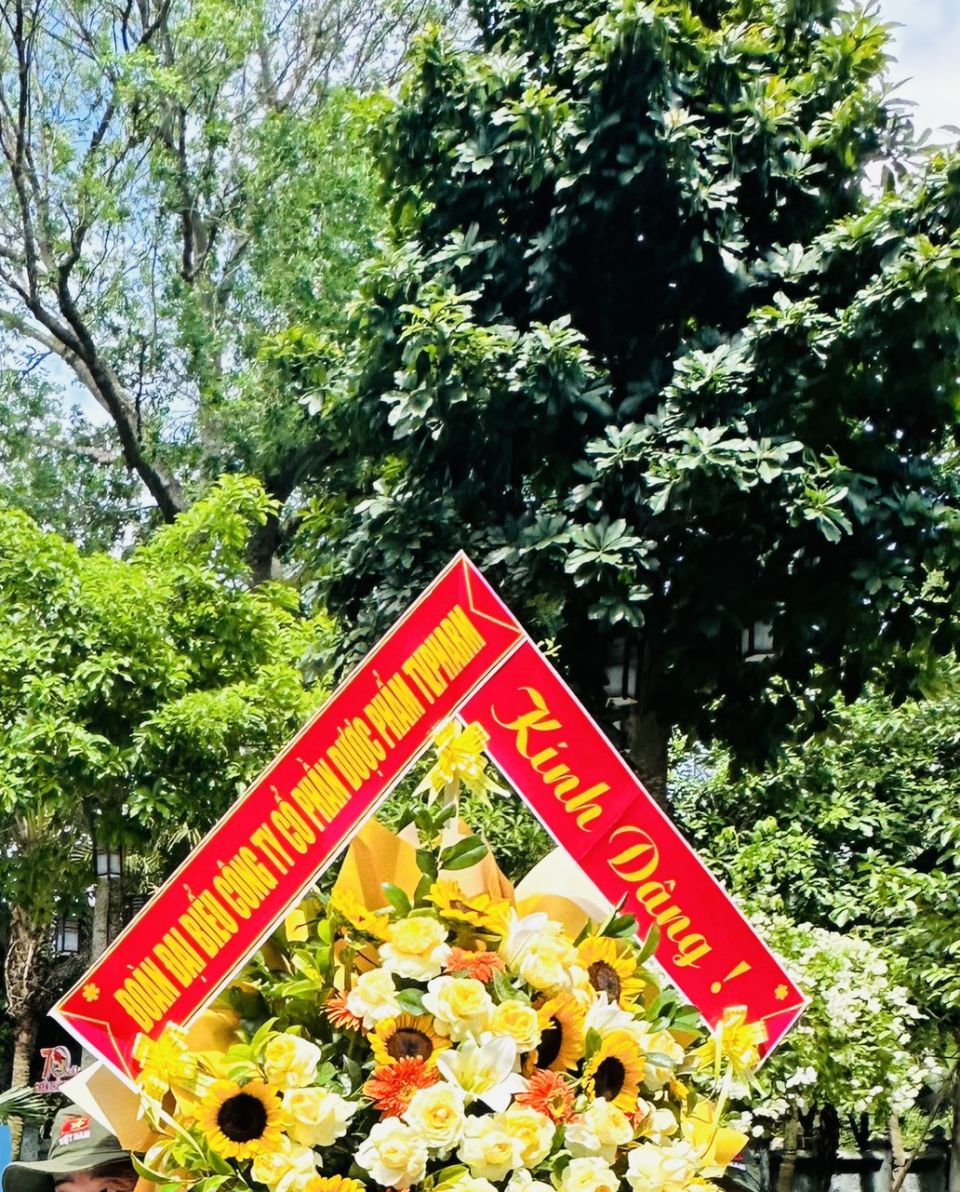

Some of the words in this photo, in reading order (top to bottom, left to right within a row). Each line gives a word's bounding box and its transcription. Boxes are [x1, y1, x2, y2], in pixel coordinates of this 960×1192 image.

[401, 604, 487, 704] TVPHARM
[363, 669, 426, 749] PHẨM
[326, 717, 386, 791] DƯỢC
[270, 785, 316, 854] CỔ
[291, 757, 352, 832] PHẦN
[490, 686, 611, 833] Kính
[608, 825, 713, 969] Dâng
[213, 846, 279, 920] CÔNG
[249, 822, 296, 875] TY
[153, 927, 207, 988] ĐẠI
[178, 884, 239, 959] BIỂU
[113, 957, 181, 1033] ĐOÀN
